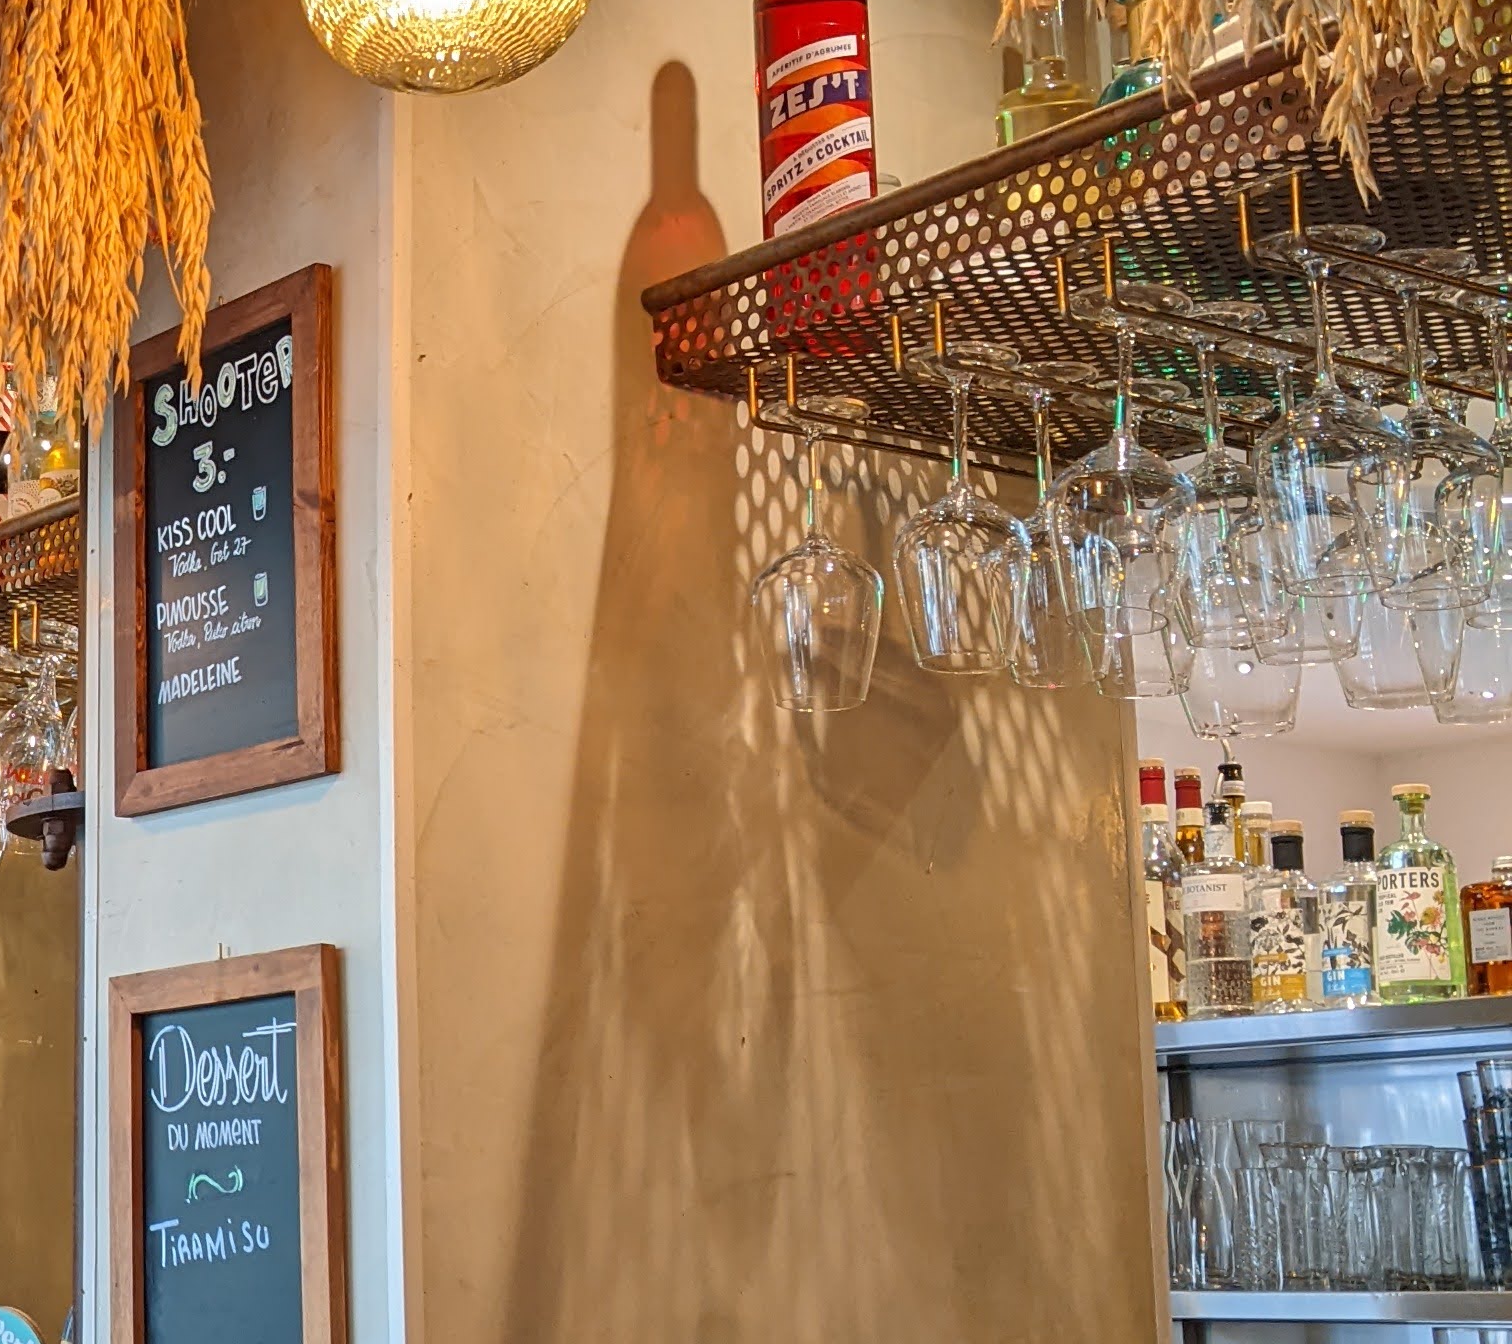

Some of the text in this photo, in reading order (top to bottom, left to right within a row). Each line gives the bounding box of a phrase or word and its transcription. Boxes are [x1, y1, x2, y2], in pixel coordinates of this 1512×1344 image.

[765, 162, 805, 202] SPRITZ
[815, 129, 871, 162] COCKTAIL
[156, 503, 237, 553] KISS COOL
[210, 540, 230, 566] Get
[232, 536, 252, 557] 27
[156, 585, 229, 631] PIMOUSSE
[157, 656, 242, 705] MADELEINE
[148, 1016, 297, 1113] Dessert
[168, 1123, 190, 1152] DU
